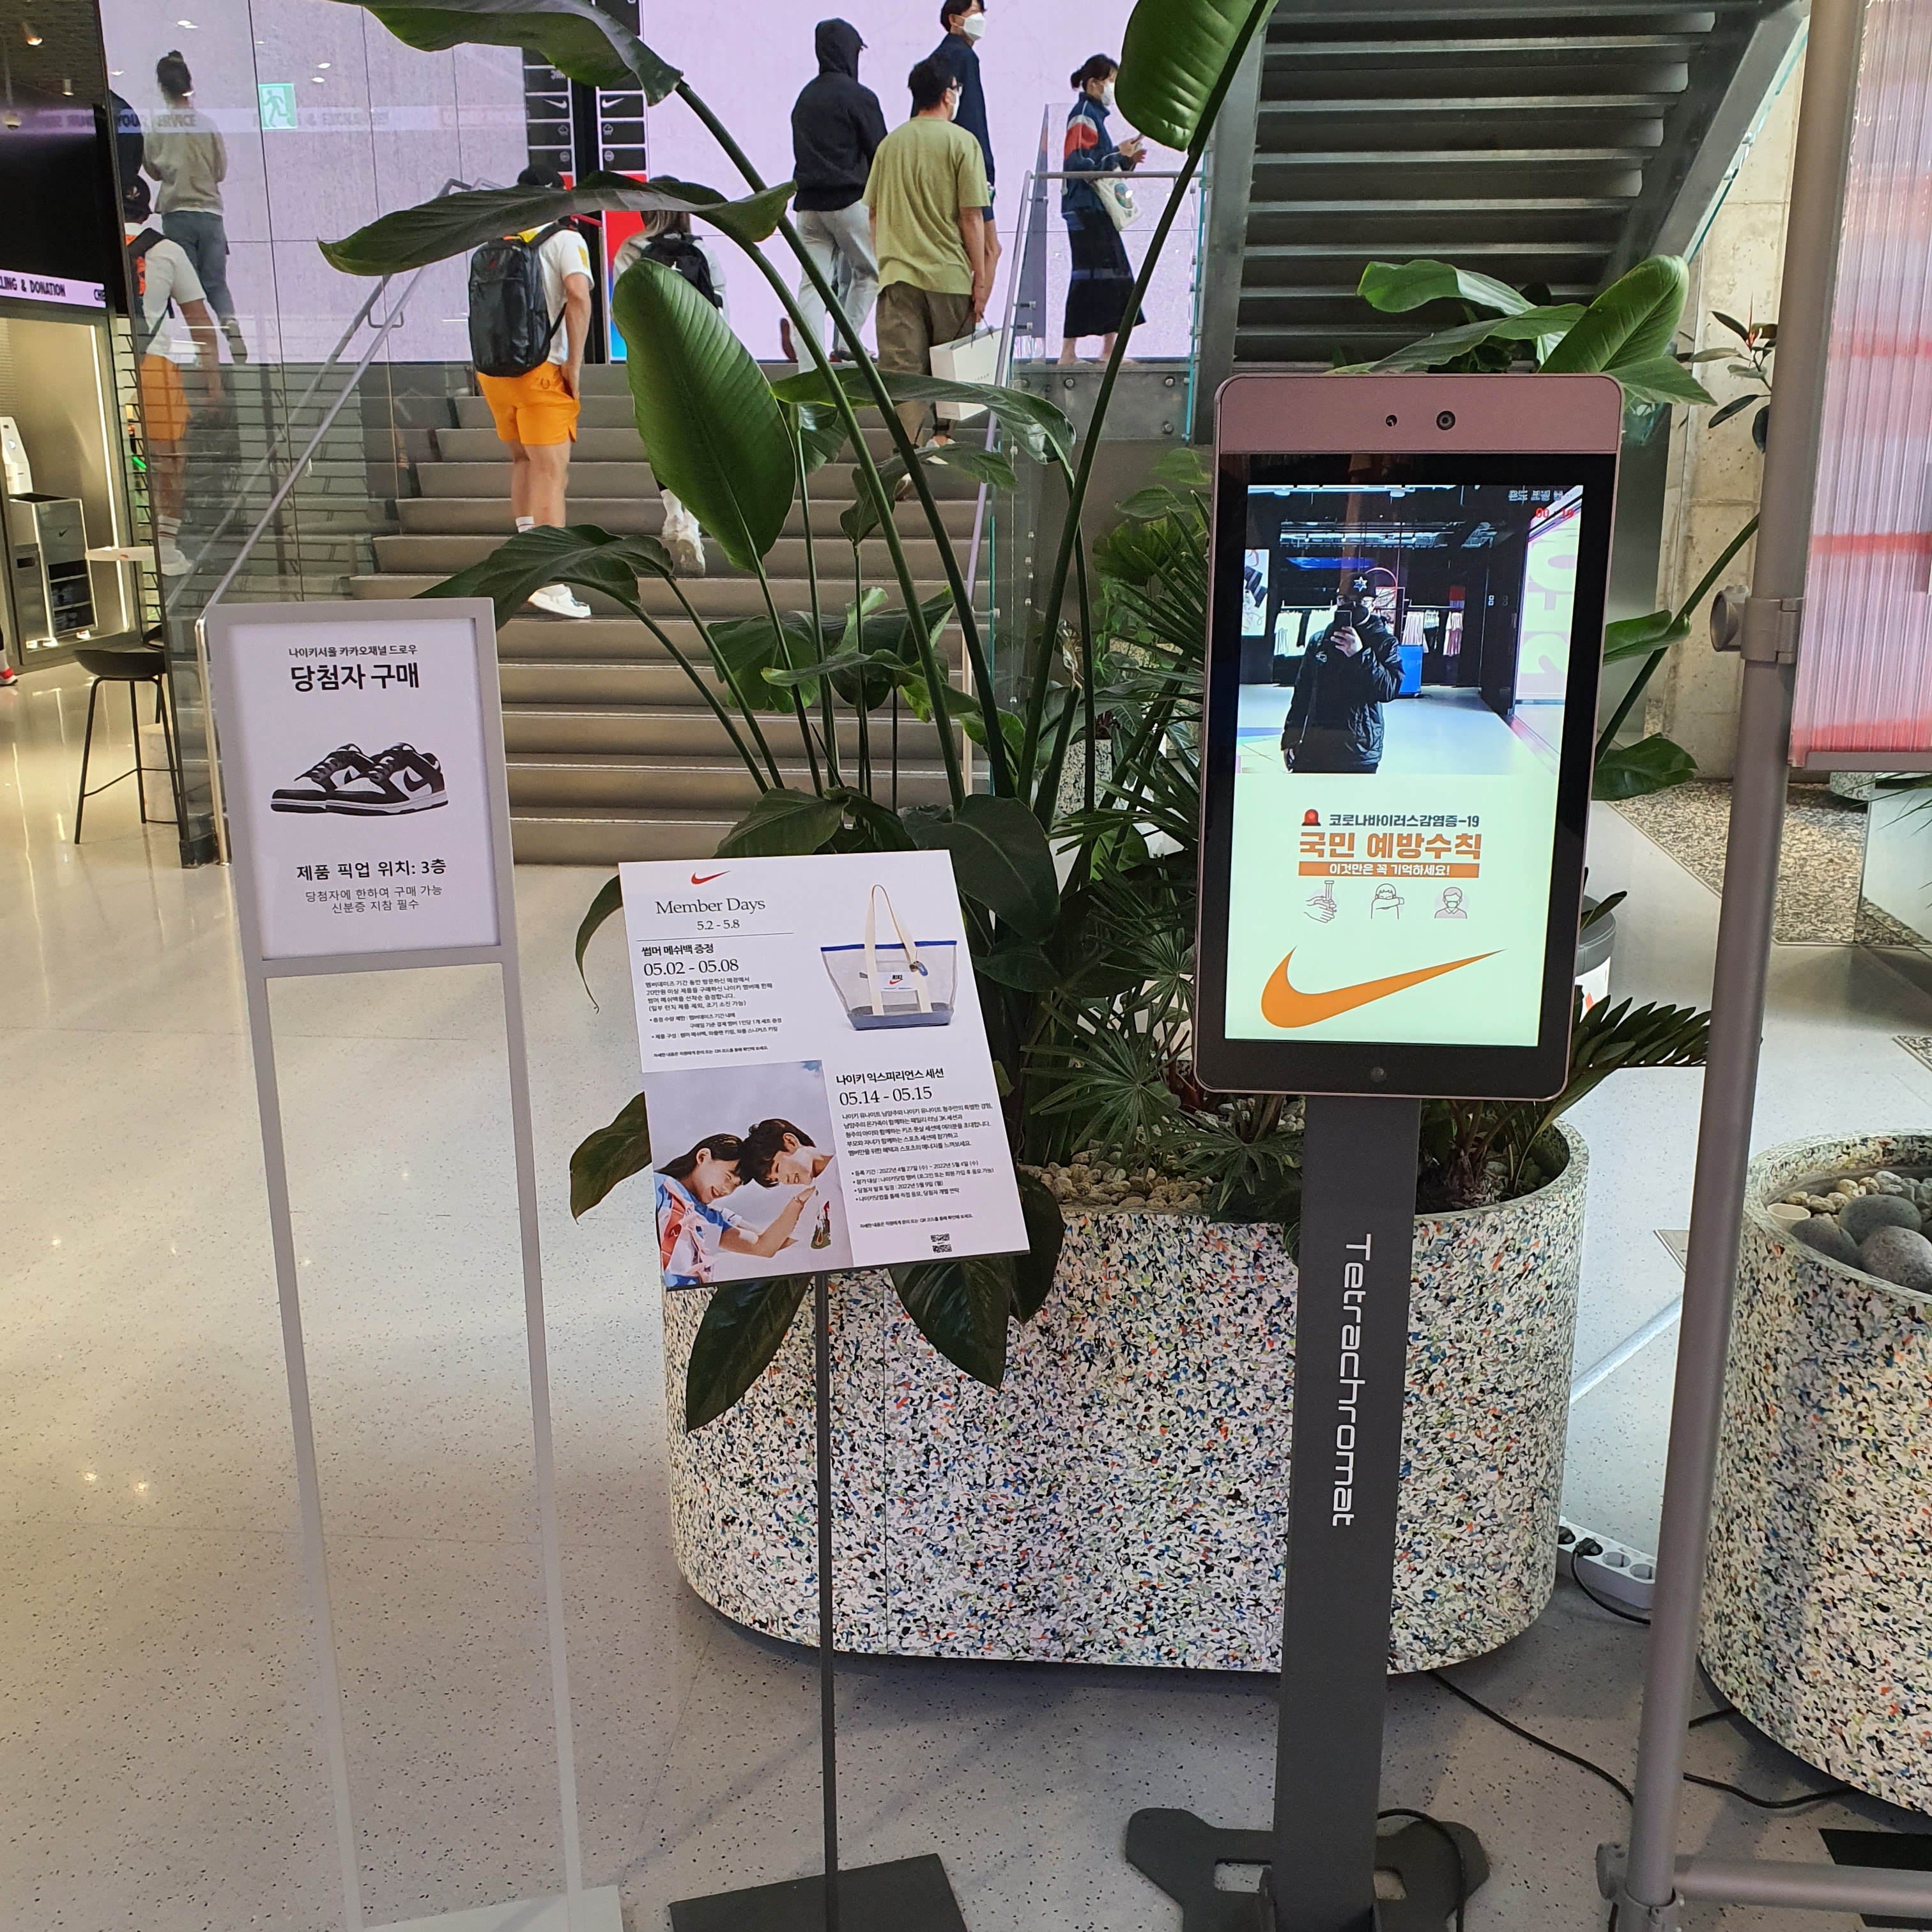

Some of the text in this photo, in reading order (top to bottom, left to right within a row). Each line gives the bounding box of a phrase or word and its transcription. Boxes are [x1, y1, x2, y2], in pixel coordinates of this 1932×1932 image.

[21, 279, 27, 292] &
[29, 280, 66, 297] DONATION
[288, 645, 418, 658] 나이키서울 카카오채널 드로우
[291, 662, 419, 693] 당첨자 구매
[1329, 814, 1480, 827] 코로나바이러스감염증-19
[1300, 832, 1482, 860] 국민 예방수칙
[296, 858, 447, 881] 제품 픽업 위치: 3층
[1329, 863, 1450, 876] 이것만은 꼭 기억하세요!
[305, 884, 442, 903] 당첨자에 한하여 구매 가능
[332, 898, 419, 914] 신분증 지참 필수
[654, 898, 766, 914] Member Days
[697, 921, 714, 930] 5.2
[723, 919, 740, 929] 5.8
[641, 943, 714, 956] 썸머 메쉬백 증정
[643, 962, 686, 976] 05.02
[698, 958, 739, 973] 05.08
[836, 1068, 944, 1085] 나이키 익스피리언스 세션
[839, 1090, 880, 1106] 05.14
[893, 1086, 932, 1101] 05.15
[1333, 1234, 1371, 1526] Tetrachromat
